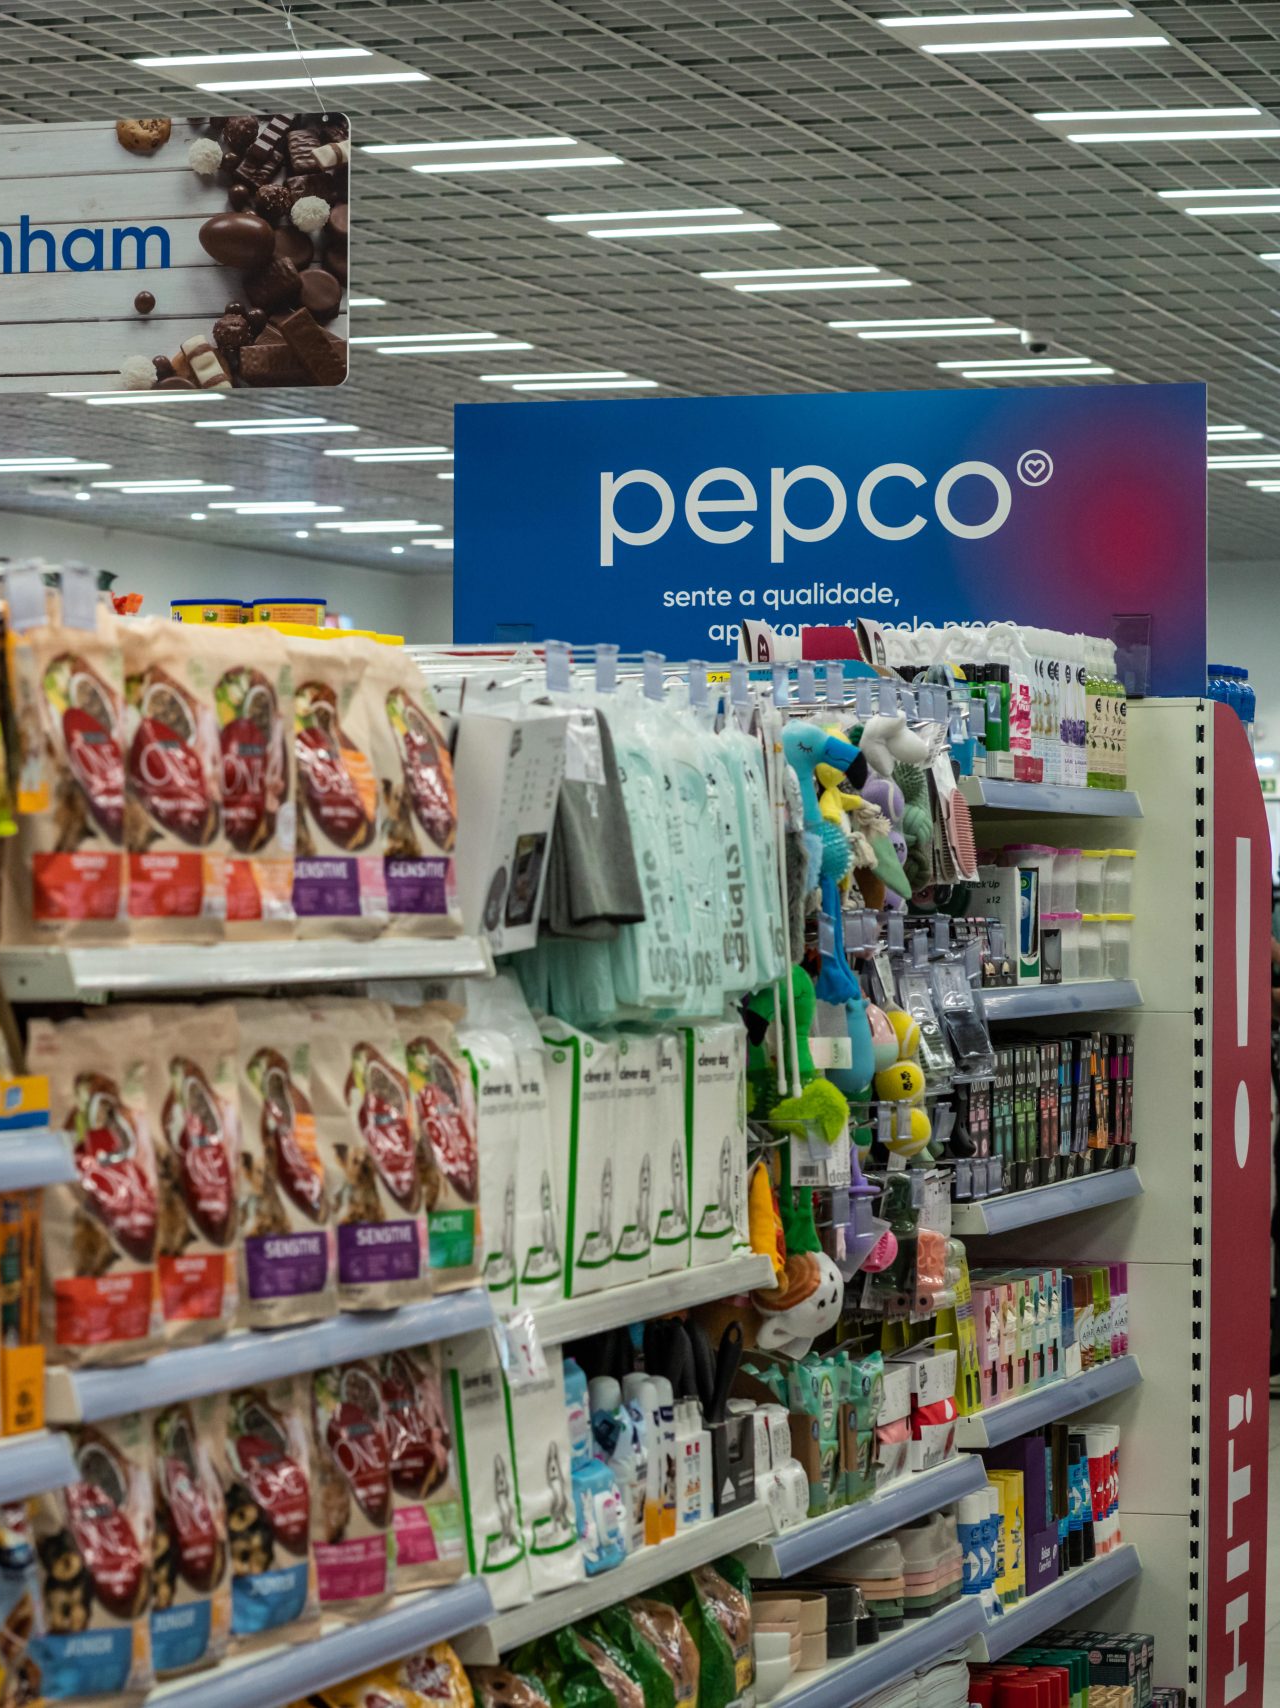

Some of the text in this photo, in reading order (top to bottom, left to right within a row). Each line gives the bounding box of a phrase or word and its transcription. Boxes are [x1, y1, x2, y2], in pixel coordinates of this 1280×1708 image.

[600, 460, 1012, 567] pepco
[663, 582, 900, 611] sente a qualidade,
[334, 1433, 385, 1478] ONE
